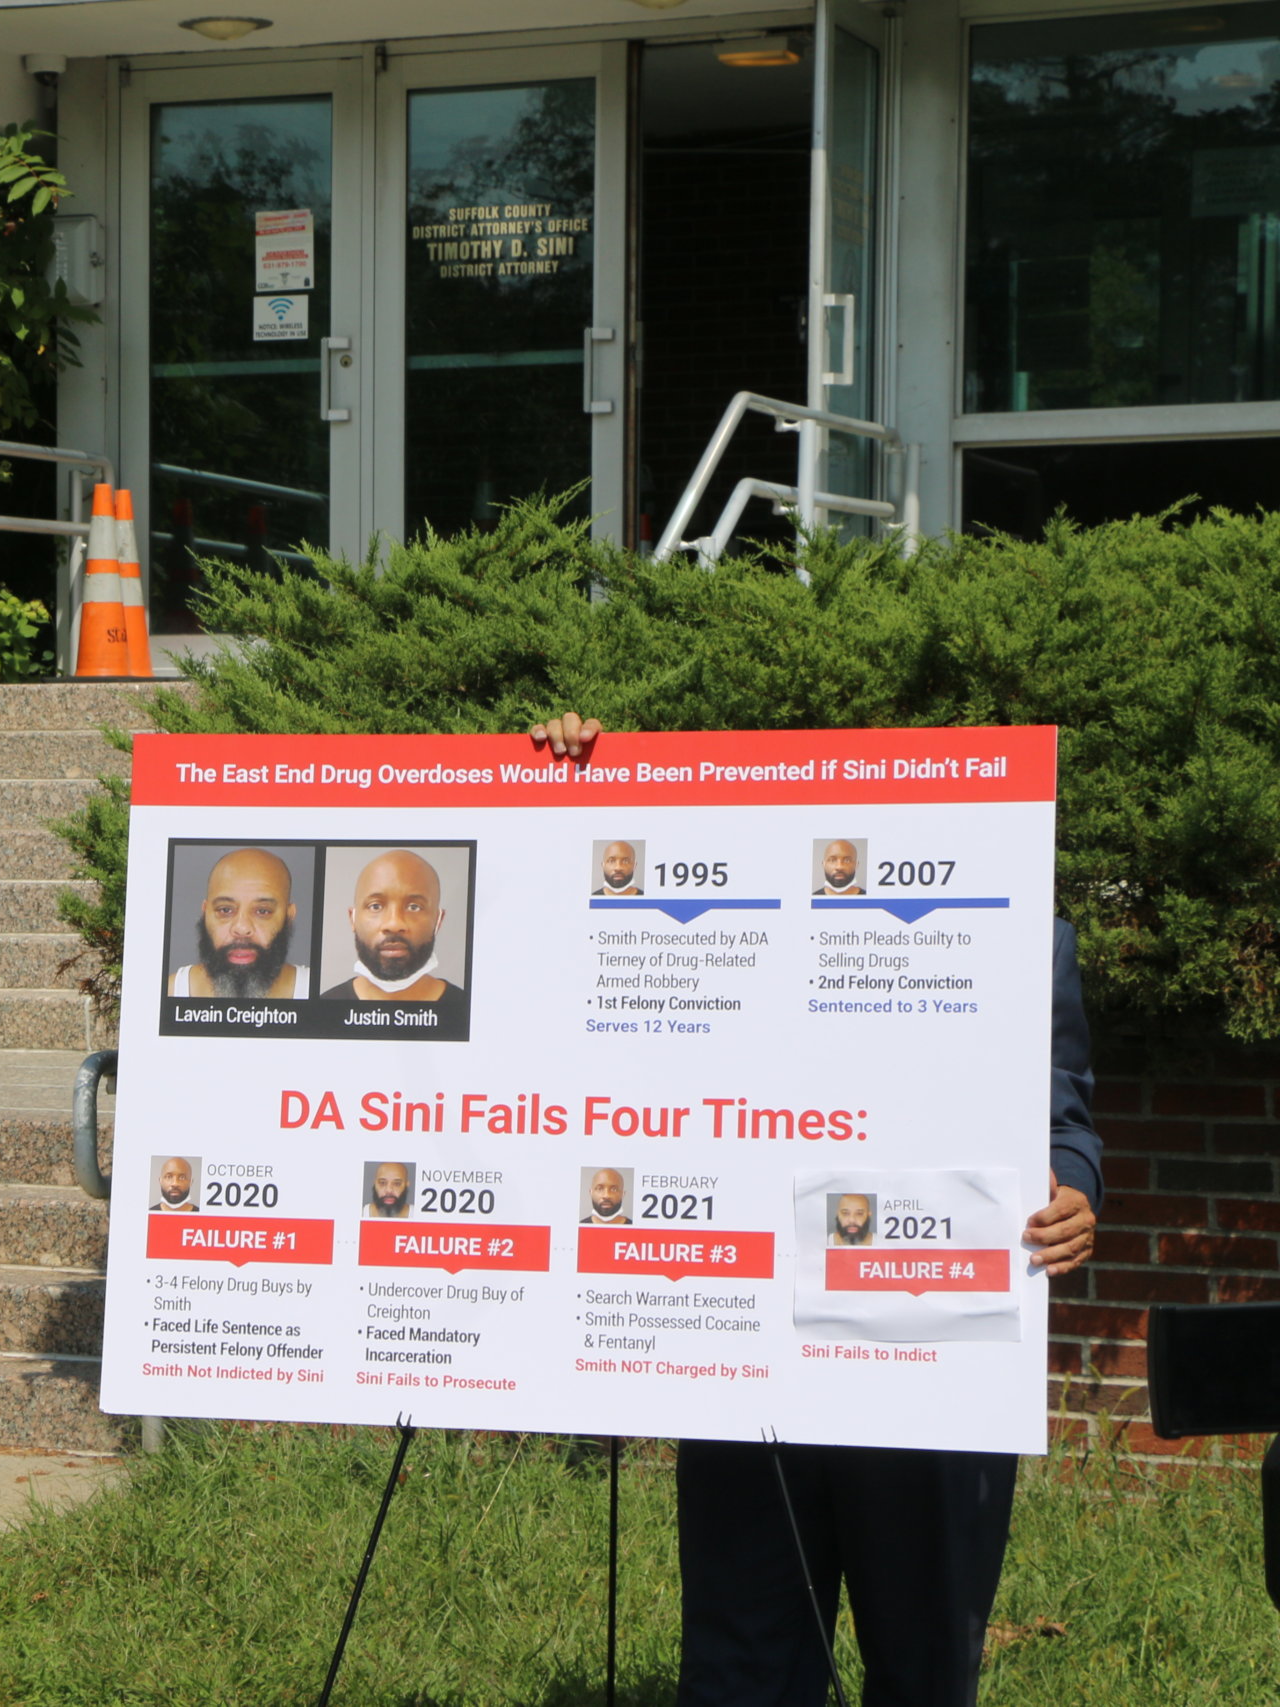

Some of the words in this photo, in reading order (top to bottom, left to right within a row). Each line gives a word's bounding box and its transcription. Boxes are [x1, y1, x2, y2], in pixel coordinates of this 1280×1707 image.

[449, 207, 500, 220] SUFFOLK
[504, 204, 551, 218] COUNTY
[412, 224, 465, 239] DISTRICT
[471, 221, 542, 236] ATTORNEY'S
[548, 218, 588, 232] OFFICE
[426, 239, 503, 261] TIMOTHY
[511, 239, 528, 257] D.
[537, 237, 574, 256] SINI
[440, 263, 494, 278] DISTRICT
[498, 261, 559, 274] ATTORNEY
[176, 763, 217, 783] The
[222, 764, 269, 783] East
[274, 764, 315, 783] End
[321, 764, 372, 788] Drug
[378, 764, 493, 784] Overdoses
[500, 763, 568, 783] Would
[575, 763, 630, 783] Have
[636, 762, 693, 782] Been
[699, 759, 815, 781] Prevented
[821, 759, 837, 780] if
[842, 759, 886, 780] Sini
[965, 756, 1007, 777] Fail
[654, 862, 728, 887] 1995
[877, 861, 956, 886] 2007
[598, 930, 637, 945] Smith
[641, 931, 716, 946] Prosecuted
[720, 931, 736, 949] by
[739, 931, 769, 945] ADA
[819, 930, 859, 946] Smith
[863, 931, 910, 946] Pleads
[913, 930, 953, 949] Guilty
[957, 932, 972, 946] to
[598, 952, 646, 970] Tierney
[649, 953, 663, 967] of
[667, 953, 756, 970] Drug-Related
[819, 953, 865, 971] Selling
[868, 953, 910, 971] Drugs
[596, 974, 640, 989] Armed
[644, 974, 700, 992] Robbery
[818, 974, 844, 990] 2nd
[848, 975, 894, 993] Felony
[898, 974, 973, 990] Conviction
[596, 996, 617, 1010] 1st
[621, 996, 665, 1013] Felony
[669, 996, 741, 1011] Conviction
[808, 999, 892, 1013] Sentenced
[897, 1001, 913, 1013] to
[918, 999, 927, 1013] 3
[933, 999, 978, 1014] Years
[175, 1006, 222, 1024] Lavain
[226, 1007, 297, 1028] Creighton
[344, 1009, 390, 1026] Justin
[394, 1010, 438, 1027] Smith
[586, 1019, 638, 1033] Serves
[644, 1020, 662, 1033] 12
[668, 1020, 711, 1034] Years
[279, 1090, 345, 1130] DA
[358, 1091, 445, 1133] Sini
[460, 1093, 568, 1136] Fails
[584, 1096, 690, 1138] Four
[702, 1097, 868, 1142] Times:
[207, 1164, 273, 1177] OCTOBER
[421, 1170, 503, 1184] NOVEMBER
[641, 1175, 719, 1189] FEBRUARY
[206, 1182, 279, 1208] 2020
[420, 1188, 495, 1214] 2020
[641, 1194, 714, 1220] 2021
[883, 1200, 924, 1211] APRIL
[884, 1216, 952, 1239] 2021
[181, 1229, 267, 1249] FAILURE
[272, 1232, 296, 1250] #1
[394, 1235, 482, 1255] FAILURE
[487, 1238, 514, 1257] #2
[614, 1242, 704, 1262] FAILURE
[710, 1245, 737, 1263] #3
[859, 1262, 944, 1279] FAILURE
[949, 1262, 975, 1279] #4
[155, 1275, 178, 1289] 3-4
[182, 1276, 224, 1294] Felony
[227, 1277, 258, 1295] Drug
[261, 1279, 293, 1296] Buys
[297, 1279, 312, 1297] by
[368, 1283, 443, 1299] Undercover
[447, 1285, 478, 1304] Drug
[481, 1286, 507, 1304] Buy
[510, 1286, 525, 1301] of
[154, 1296, 192, 1311] Smith
[586, 1289, 632, 1305] Search
[636, 1291, 689, 1307] Warrant
[693, 1293, 756, 1309] Executed
[367, 1304, 431, 1323] Creighton
[585, 1312, 625, 1327] Smith
[628, 1313, 701, 1329] Possessed
[705, 1316, 761, 1332] Cocaine
[152, 1318, 191, 1333] Faced
[194, 1319, 219, 1334] Life
[222, 1320, 282, 1336] Sentence
[285, 1325, 301, 1337] as
[366, 1326, 405, 1340] Faced
[409, 1327, 481, 1347] Mandatory
[152, 1340, 217, 1355] Persistent
[220, 1342, 264, 1360] Felony
[267, 1343, 324, 1359] Offender
[584, 1334, 594, 1348] &
[598, 1334, 656, 1354] Fentanyl
[801, 1345, 830, 1358] Sini
[834, 1346, 870, 1360] Fails
[875, 1348, 889, 1361] to
[894, 1348, 937, 1362] Indict
[365, 1348, 452, 1364] Incarceration
[142, 1363, 183, 1377] Smith
[187, 1365, 212, 1378] Not
[216, 1366, 272, 1381] Indicted
[277, 1369, 293, 1384] by
[297, 1369, 324, 1382] Sini
[575, 1359, 617, 1373] Smith
[621, 1360, 652, 1374] NOT
[656, 1362, 716, 1379] Charged
[721, 1363, 737, 1380] by
[742, 1364, 769, 1378] Sini
[356, 1372, 383, 1385] Sini
[387, 1373, 420, 1387] Fails
[424, 1375, 438, 1388] to
[443, 1376, 517, 1390] Prosecute
